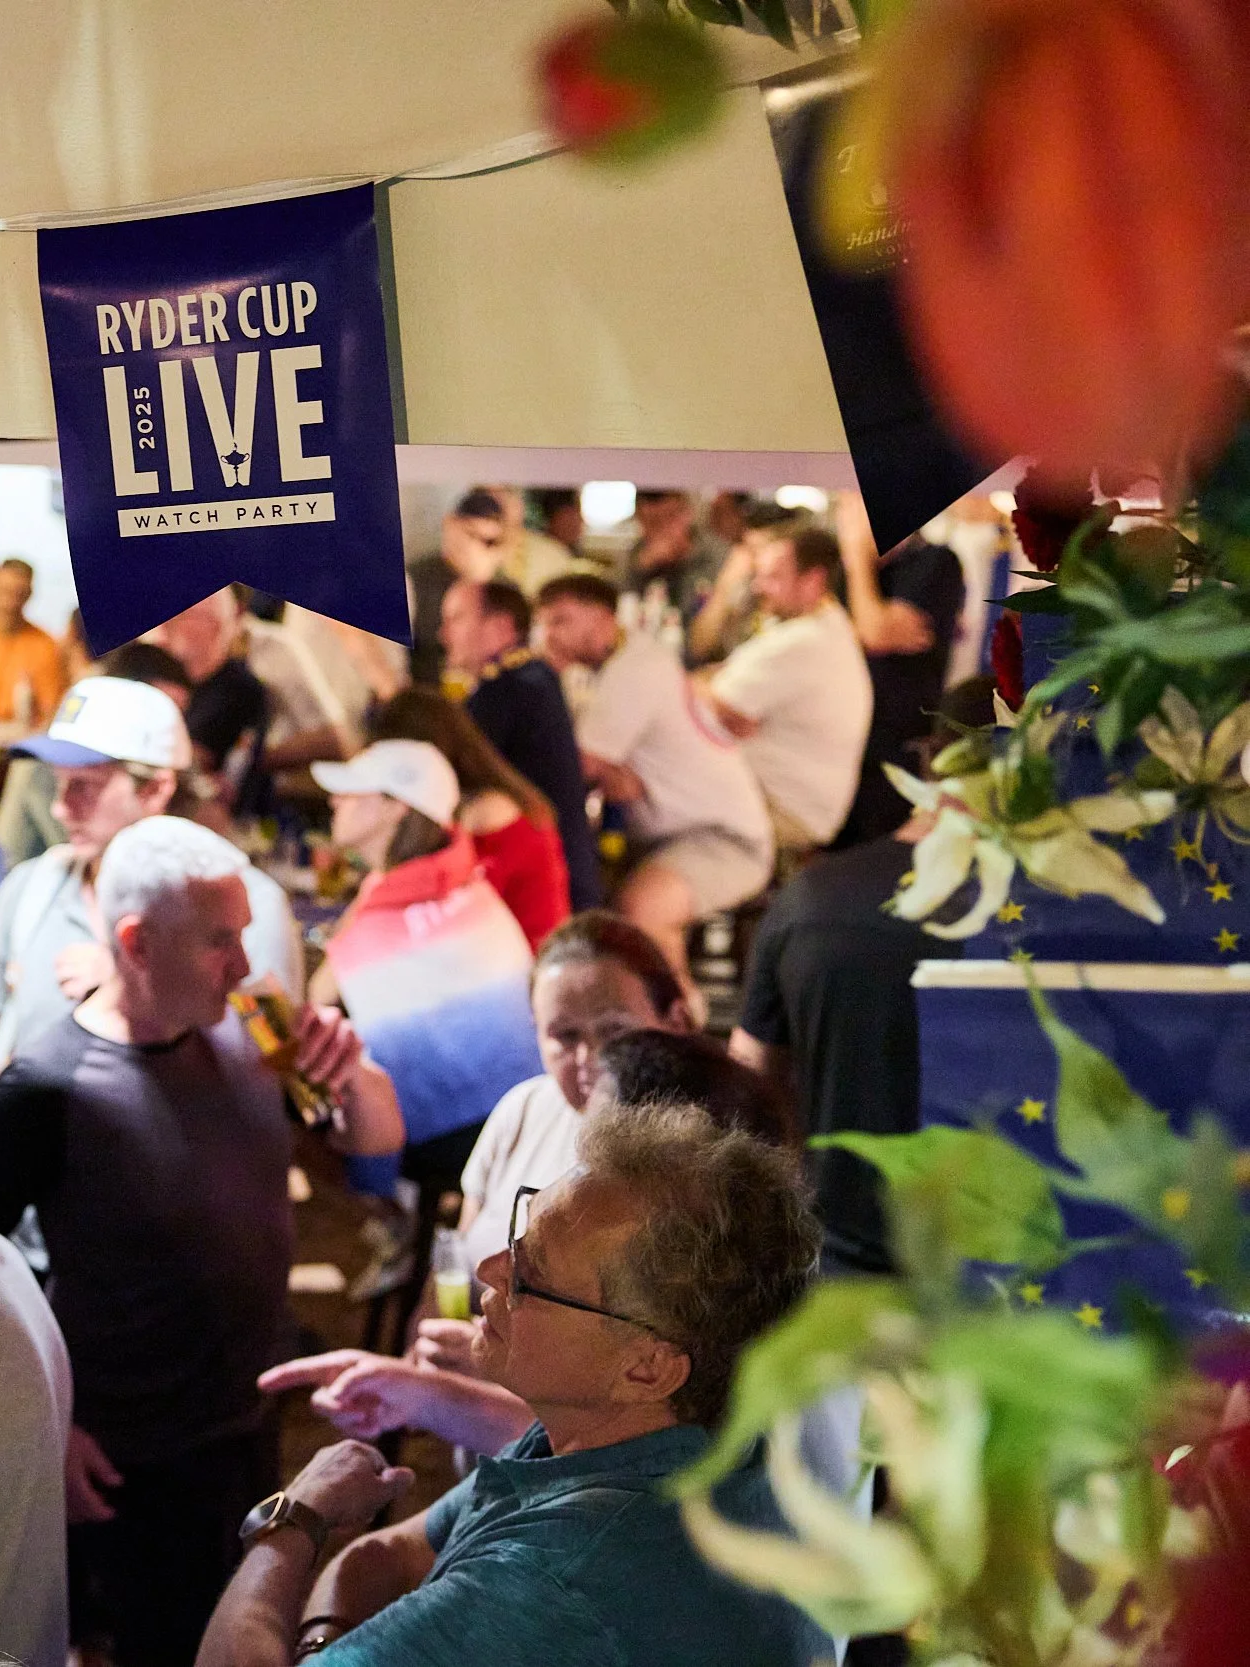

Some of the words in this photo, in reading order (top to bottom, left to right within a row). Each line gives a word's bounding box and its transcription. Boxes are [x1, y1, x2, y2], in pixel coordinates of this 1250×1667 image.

[96, 292, 230, 355] RYDER
[237, 281, 318, 339] CUP
[103, 344, 332, 497] LIVE
[133, 387, 155, 450] 2025
[135, 509, 219, 529] WATCH
[237, 502, 318, 521] PARTY
